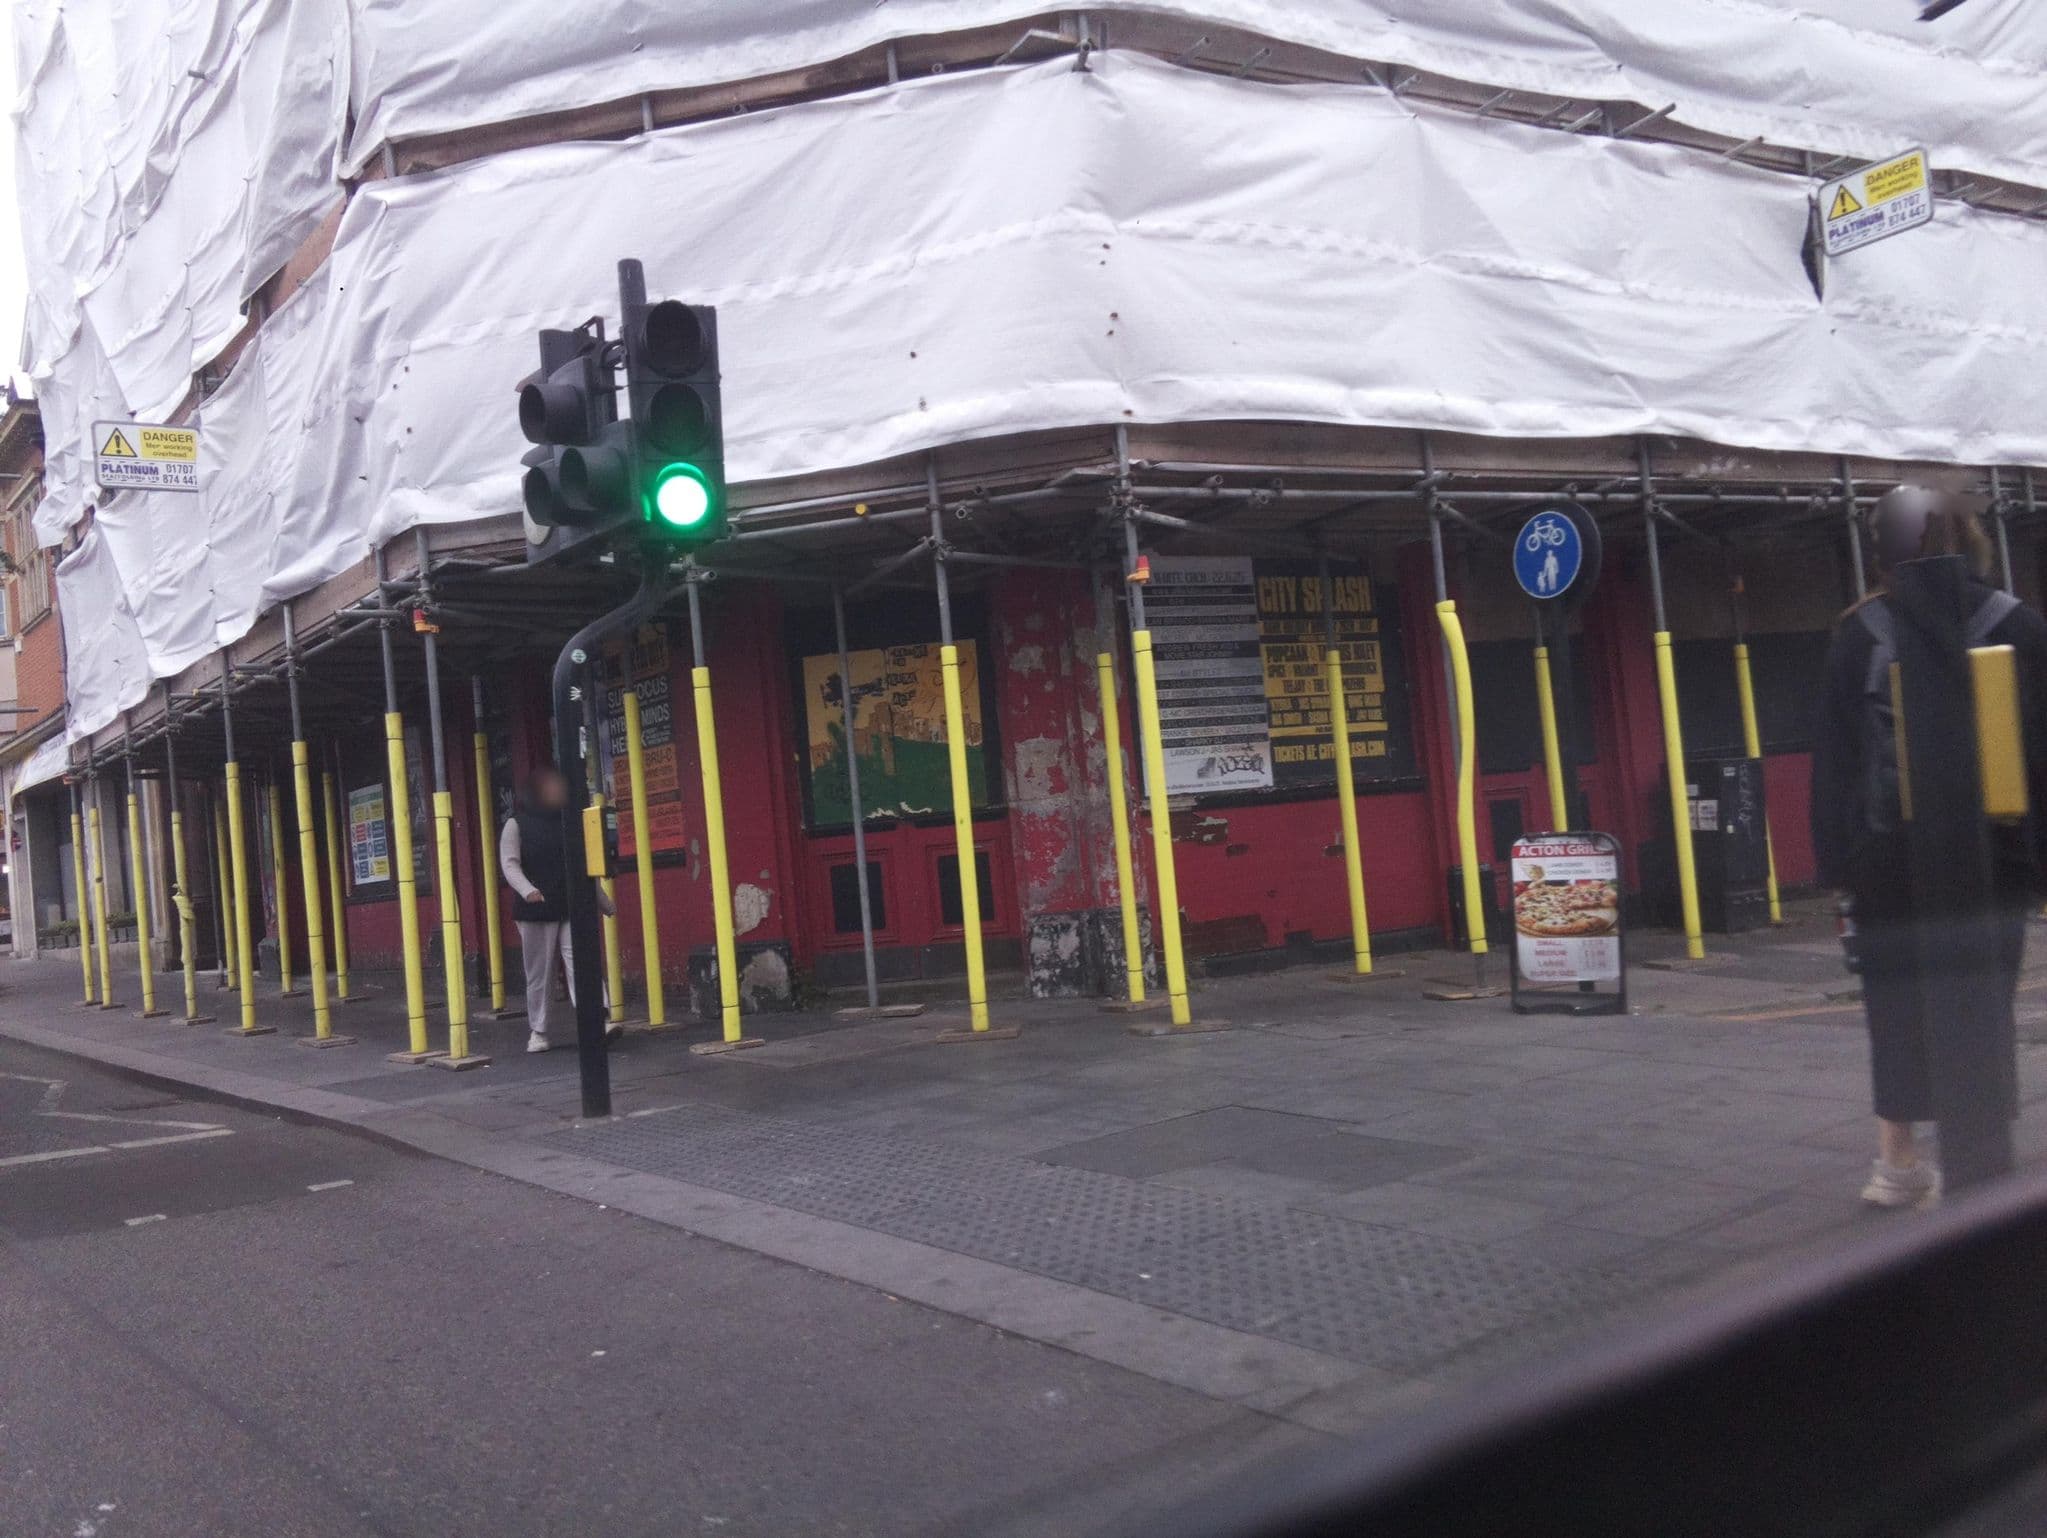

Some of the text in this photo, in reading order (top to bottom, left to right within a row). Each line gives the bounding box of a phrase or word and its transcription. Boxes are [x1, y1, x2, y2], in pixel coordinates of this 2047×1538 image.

[1867, 157, 1920, 185] DANGER
[1891, 193, 1920, 213] 01707
[1829, 211, 1884, 240] PLATINUM
[143, 431, 193, 443] DANGER
[163, 444, 193, 452] working
[101, 463, 159, 476] PLATINUM
[166, 464, 193, 474] 01707
[162, 475, 180, 484] 874
[1258, 576, 1296, 613] CITY
[608, 688, 625, 709] SU
[1519, 845, 1565, 857] ACTON
[1534, 949, 1569, 957] MEDIUM
